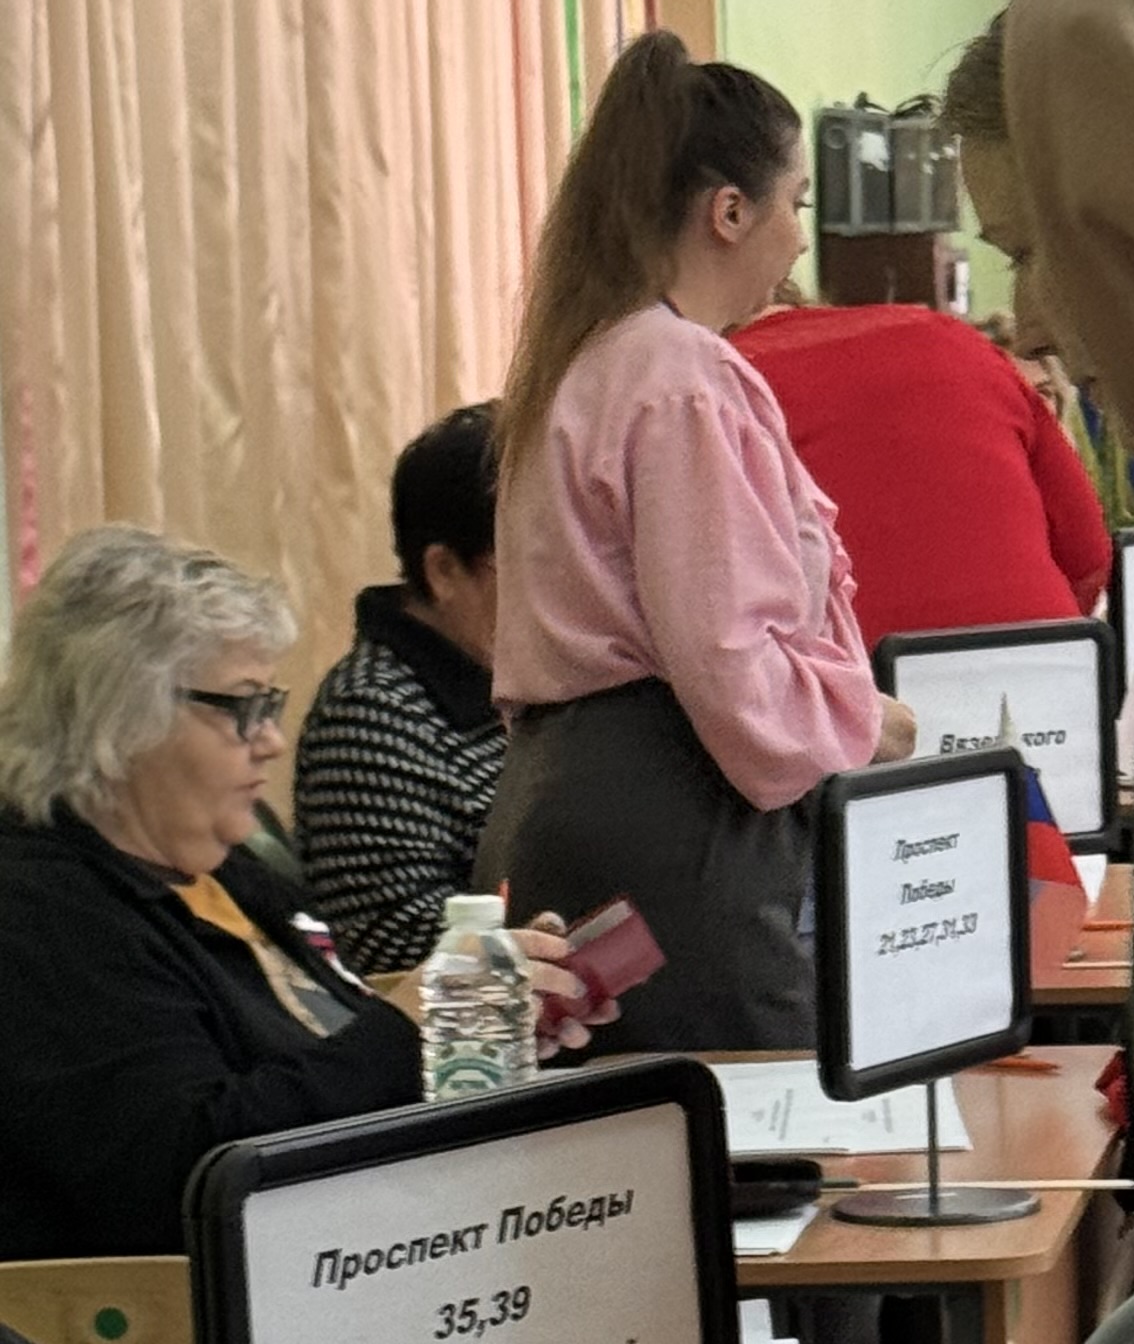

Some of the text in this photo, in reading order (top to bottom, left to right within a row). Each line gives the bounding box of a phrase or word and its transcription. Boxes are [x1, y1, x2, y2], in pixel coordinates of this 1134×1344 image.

[940, 730, 1067, 755] Вязекого
[893, 833, 960, 864] Проспект
[900, 878, 956, 905] Победы
[312, 1189, 635, 1291] Проспект Победы
[433, 1285, 532, 1340] 35,39
